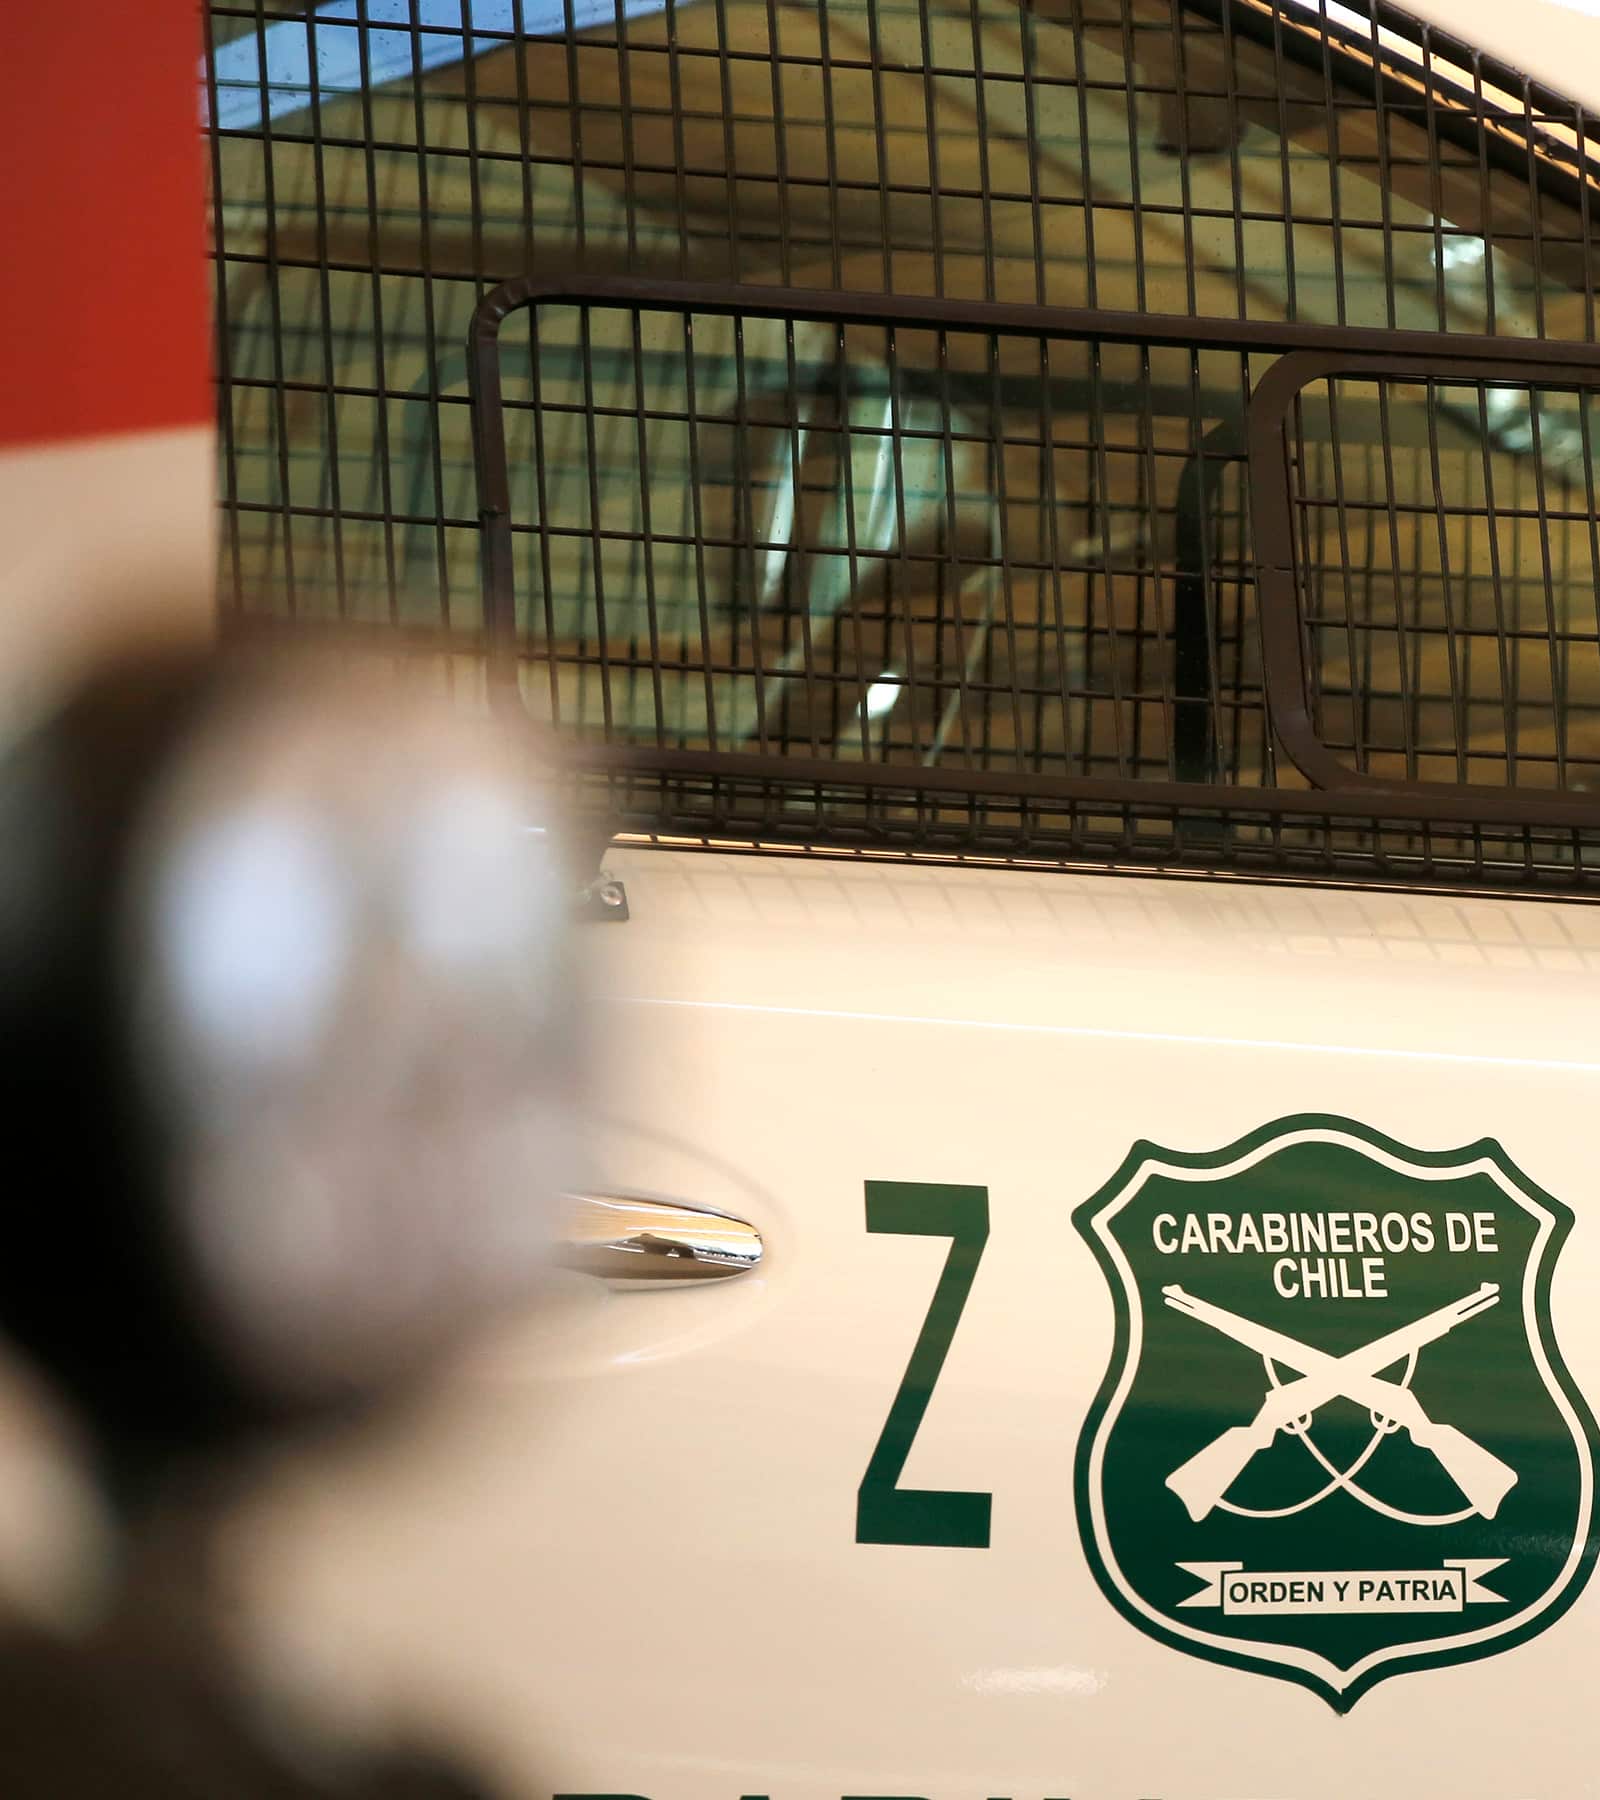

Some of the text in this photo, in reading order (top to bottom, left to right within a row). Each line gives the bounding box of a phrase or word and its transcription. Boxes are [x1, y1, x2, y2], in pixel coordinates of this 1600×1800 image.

[1152, 1212, 1499, 1254] CARABINEROS DE
[1273, 1257, 1388, 1299] CHILE
[856, 1180, 992, 1548] Z
[1229, 1579, 1457, 1604] ORDEN Y PATRIA
